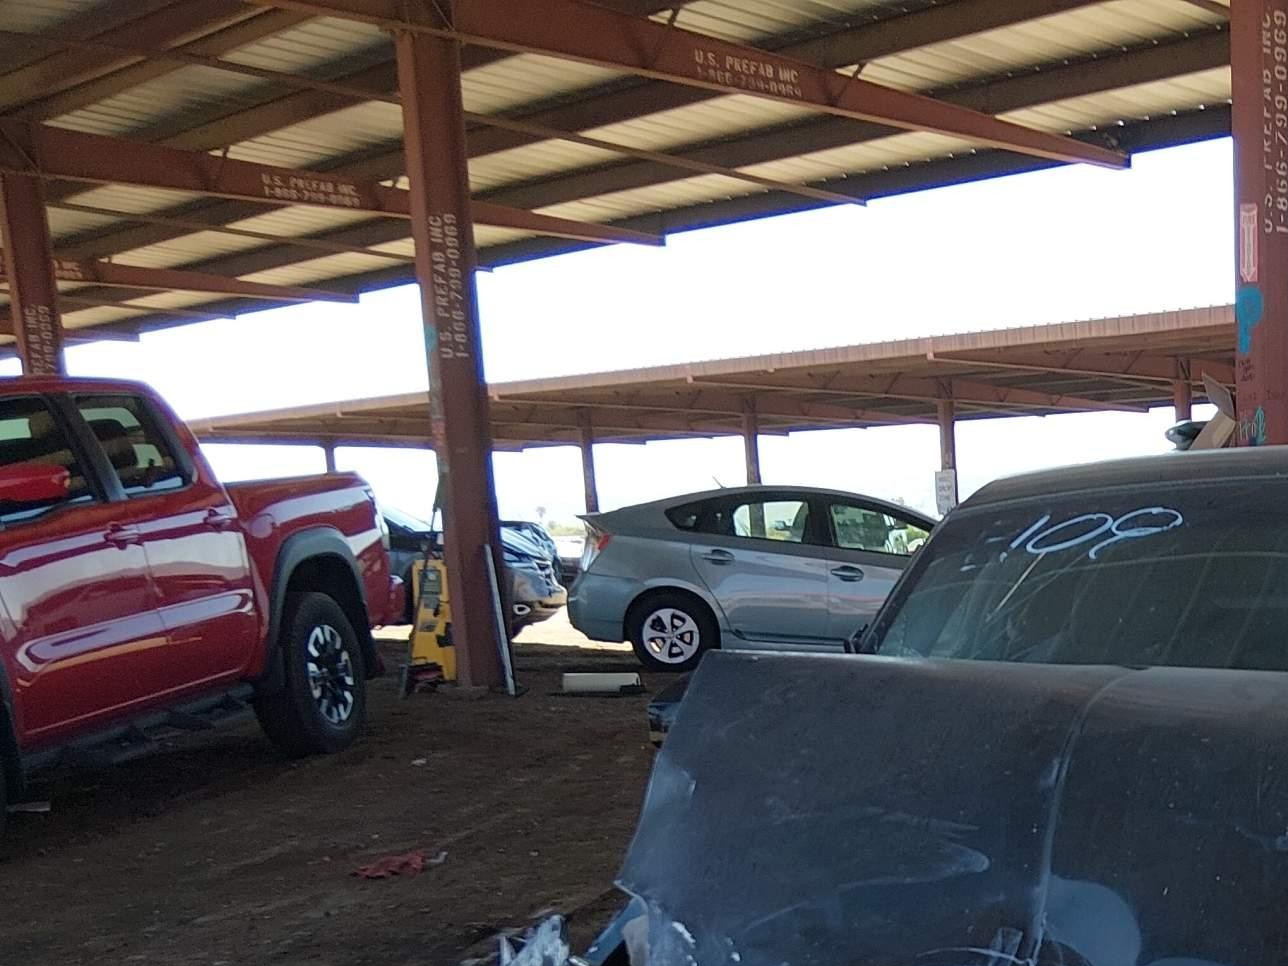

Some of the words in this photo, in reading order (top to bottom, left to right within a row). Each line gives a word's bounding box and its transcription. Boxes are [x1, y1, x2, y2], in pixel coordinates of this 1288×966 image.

[694, 48, 720, 68] U.S.
[725, 55, 774, 78] PREFAB
[1262, 68, 1273, 171] PREFAB
[1273, 9, 1288, 234] 1-866-799-0969
[432, 250, 450, 318] PREFAB
[439, 327, 453, 359] U.S.
